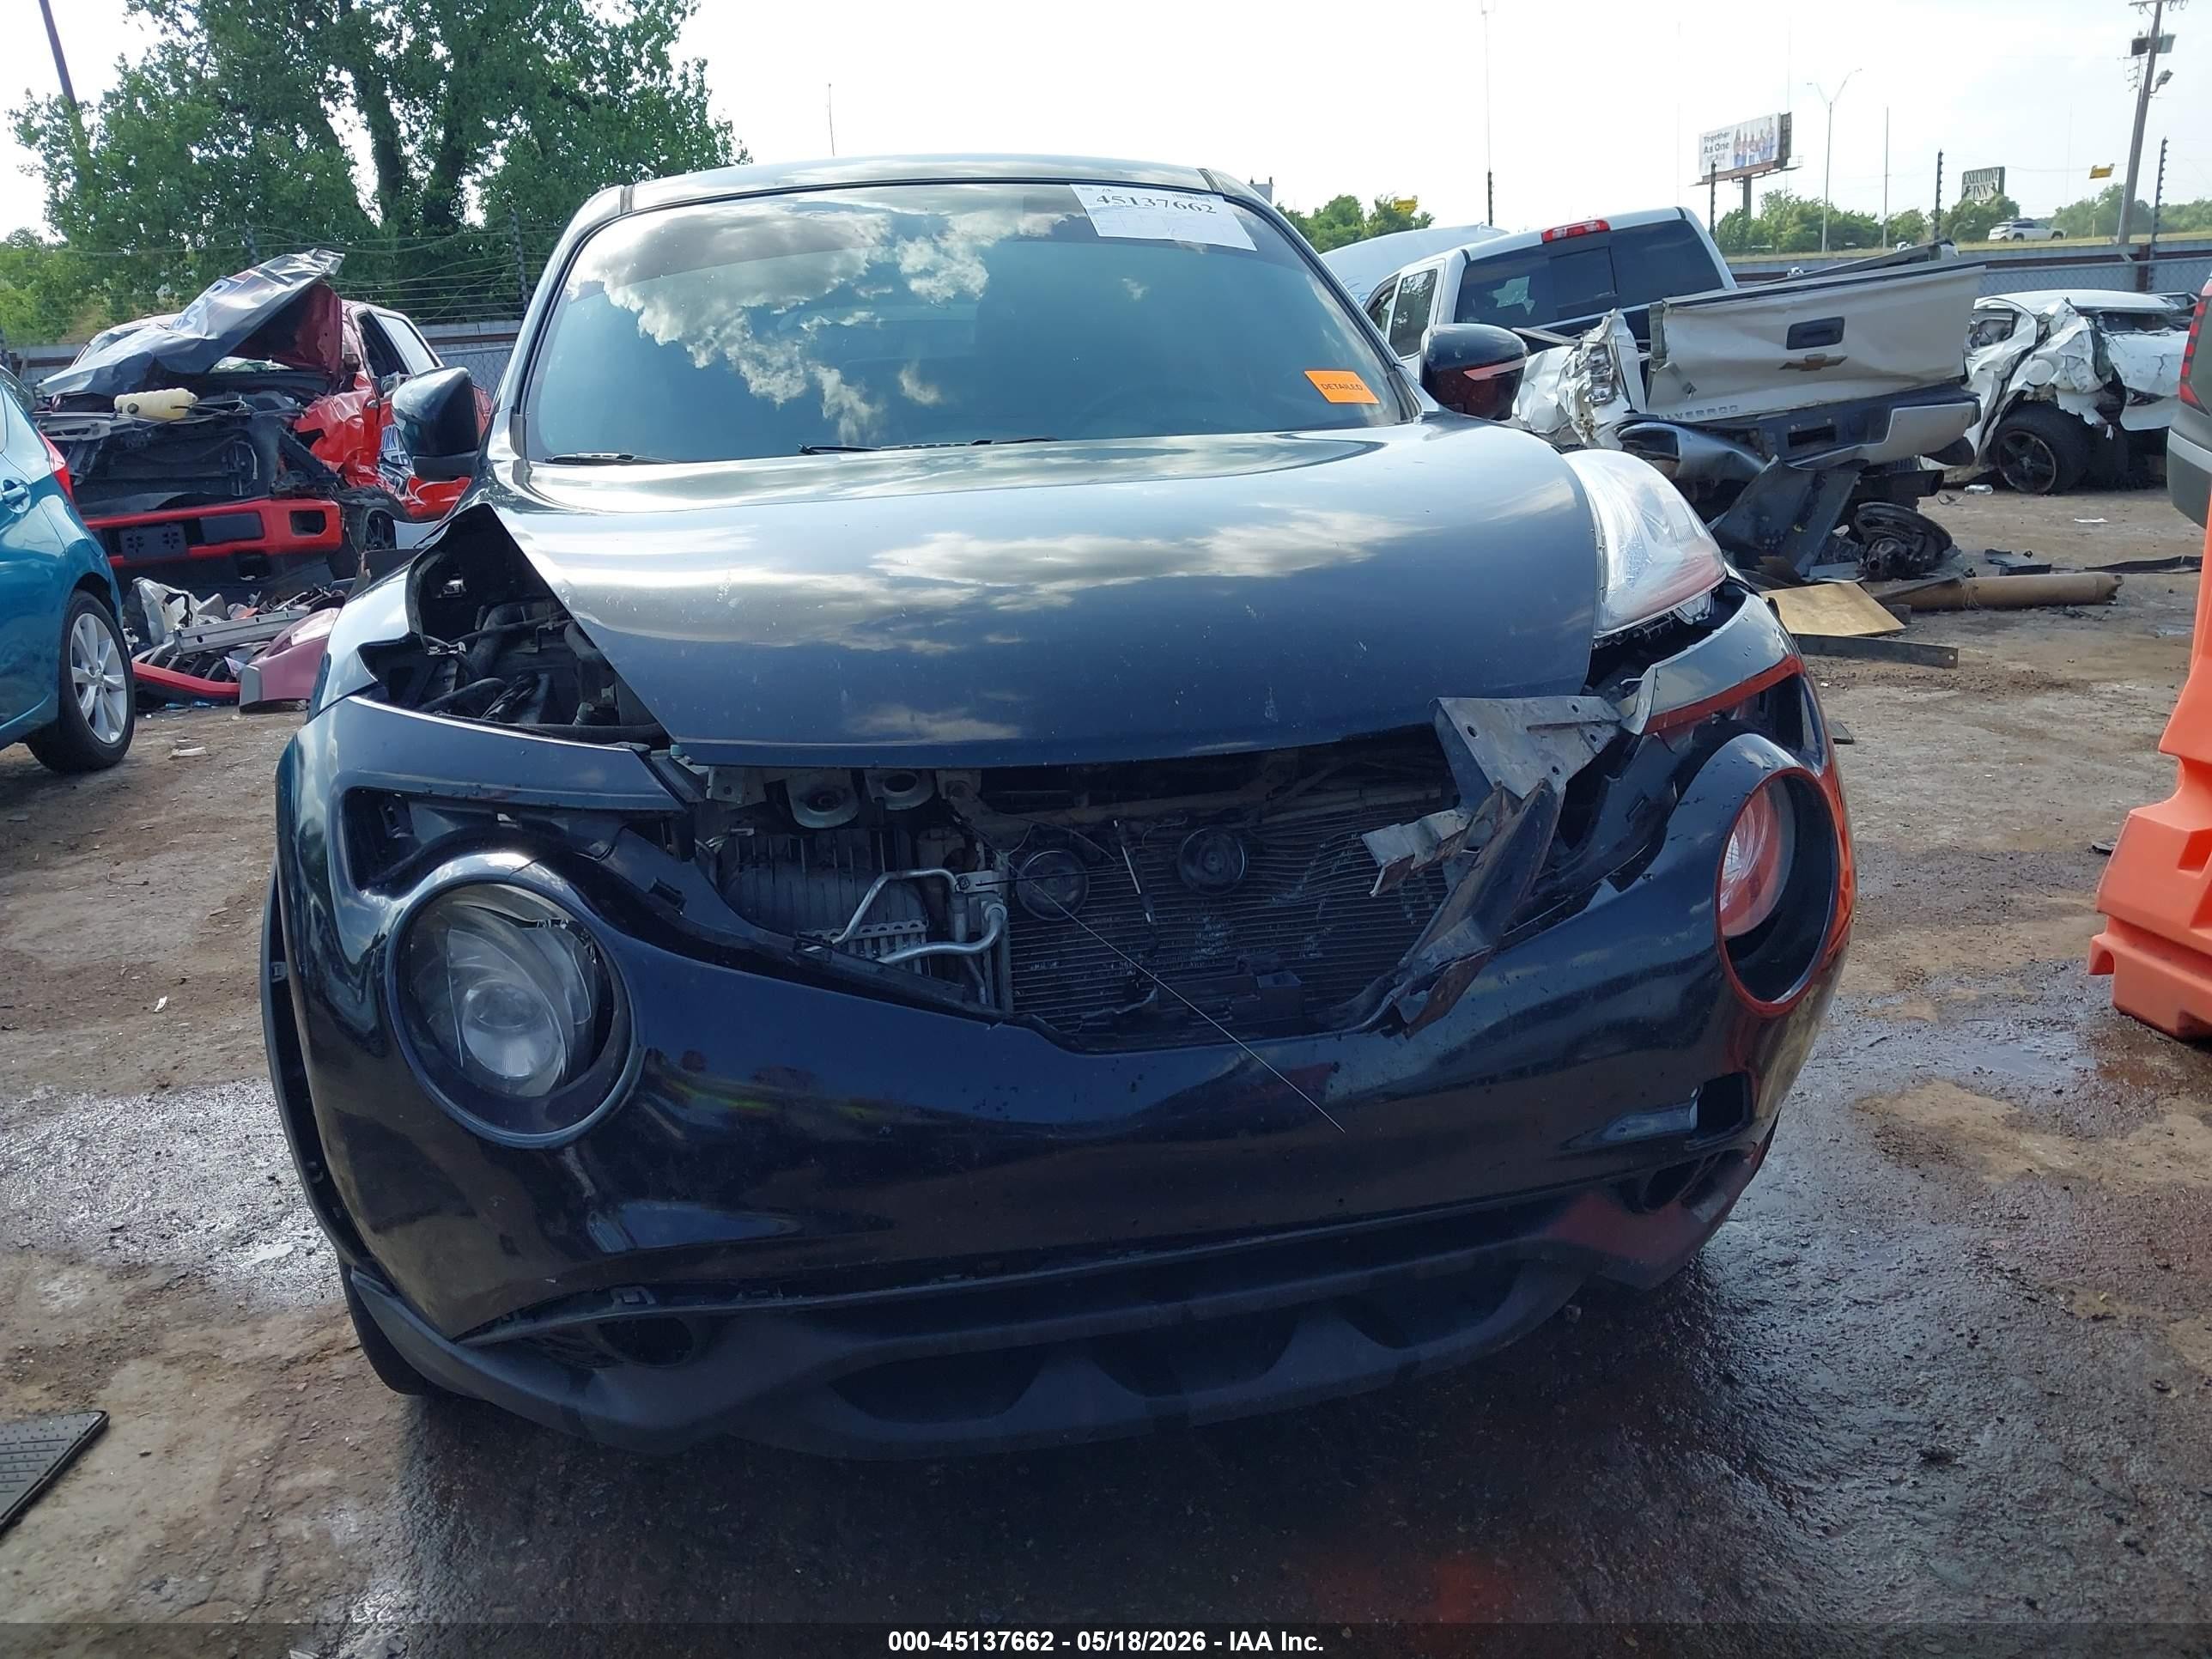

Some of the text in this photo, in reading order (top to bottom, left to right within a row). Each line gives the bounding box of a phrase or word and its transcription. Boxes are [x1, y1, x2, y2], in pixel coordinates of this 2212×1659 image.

[1714, 142, 1729, 151] One
[1963, 168, 1999, 185] EXECUTIVE
[1973, 184, 1989, 200] INN
[1096, 194, 1218, 215] 45137662
